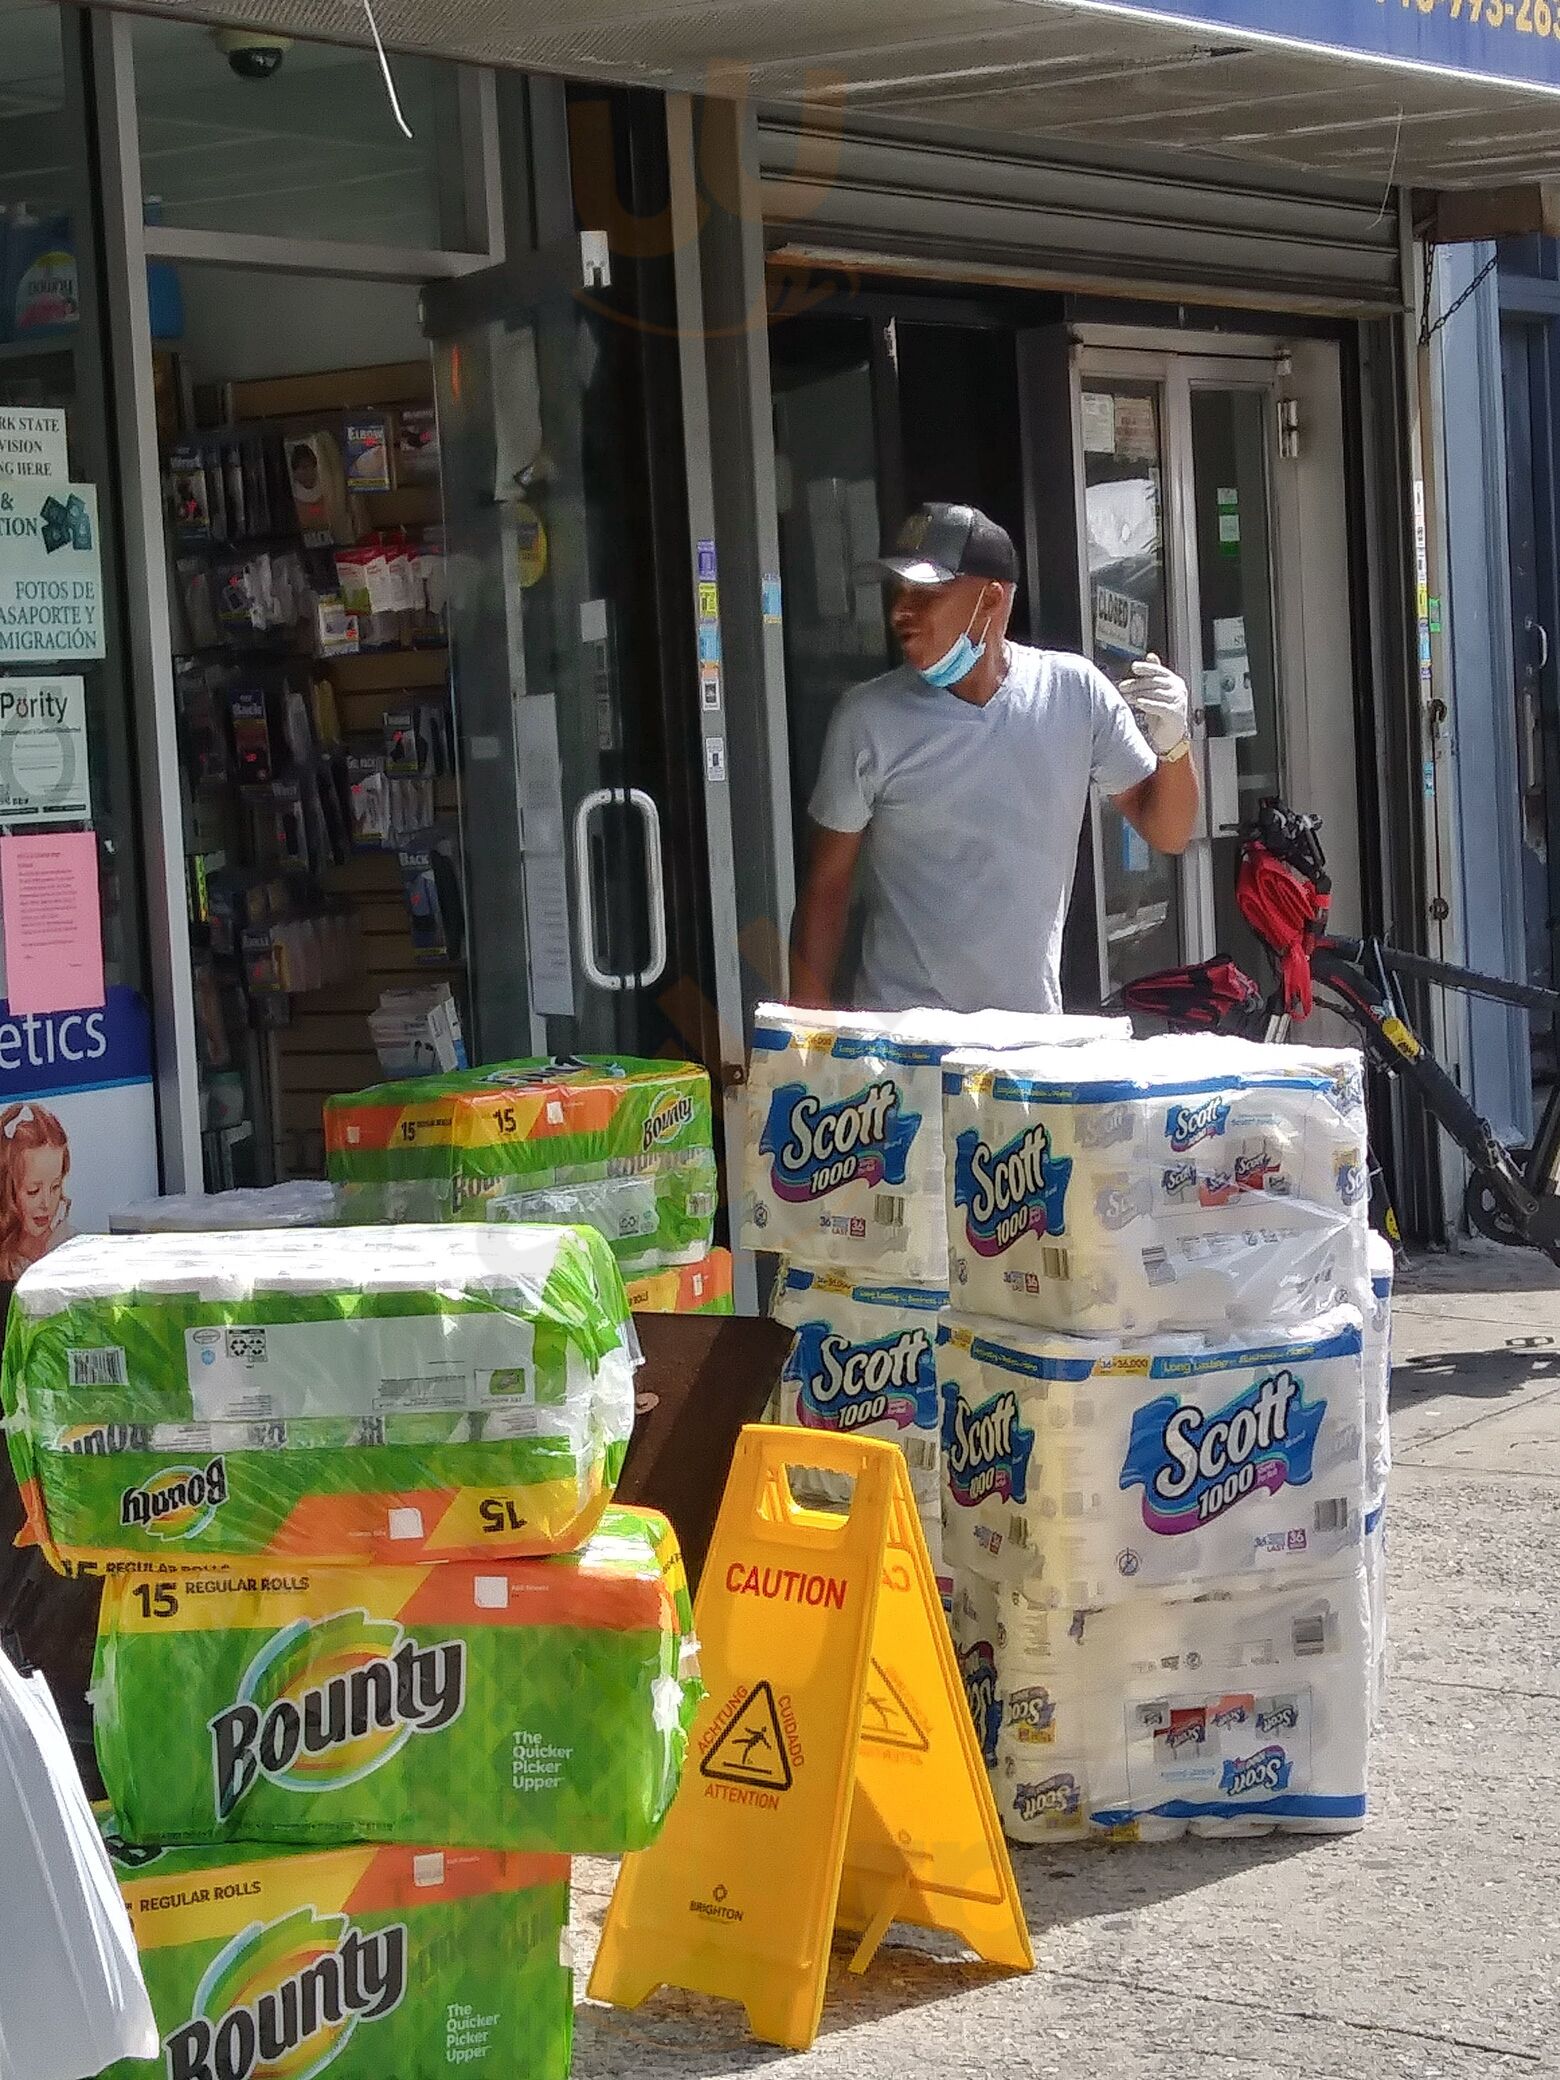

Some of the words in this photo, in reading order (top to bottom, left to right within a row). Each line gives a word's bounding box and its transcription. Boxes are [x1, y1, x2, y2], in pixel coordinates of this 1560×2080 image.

[19, 418, 60, 433] STATE
[17, 462, 53, 477] HERE
[1, 491, 14, 511] &
[16, 581, 69, 600] FOTOS
[72, 581, 95, 600] DE
[85, 606, 95, 625] Y
[401, 1121, 416, 1142] 15
[492, 1107, 517, 1133] 15
[642, 1095, 694, 1153] Bounty
[781, 1079, 897, 1171] Scott
[1176, 1095, 1223, 1142] Scott
[809, 1154, 859, 1195] 1000
[971, 1122, 1048, 1223] Scott
[996, 1202, 1031, 1247] 1000
[811, 1327, 929, 1403] Scott
[838, 1395, 888, 1429] 1000
[949, 1391, 1016, 1473] Scott
[1154, 1369, 1300, 1499] Scott
[120, 1456, 227, 1525] Bounty
[1198, 1462, 1255, 1521] 1000
[479, 1498, 528, 1533] 15
[132, 1582, 180, 1618] 15
[185, 1578, 257, 1594] REGULAR
[261, 1576, 311, 1592] ROLLS
[726, 1562, 848, 1610] CAUTION
[211, 1640, 464, 1820] Bounty
[697, 1684, 749, 1753] ACHTUNG
[777, 1693, 805, 1768] CUIDADO
[513, 1731, 542, 1745] The
[513, 1745, 573, 1761] Quicker
[513, 1760, 562, 1774] Picker
[513, 1775, 564, 1792] Upper
[1228, 1757, 1282, 1797] Scott
[704, 1782, 781, 1811] ATTENTION
[140, 1890, 211, 1913] REGULAR
[214, 1881, 262, 1899] ROLLS
[689, 1899, 744, 1922] BRIGHTON
[165, 1927, 406, 2080] Bounty
[447, 2003, 473, 2016] The
[447, 2013, 501, 2033] Quicker
[447, 2030, 489, 2049] Picker
[446, 2045, 492, 2064] Upper
